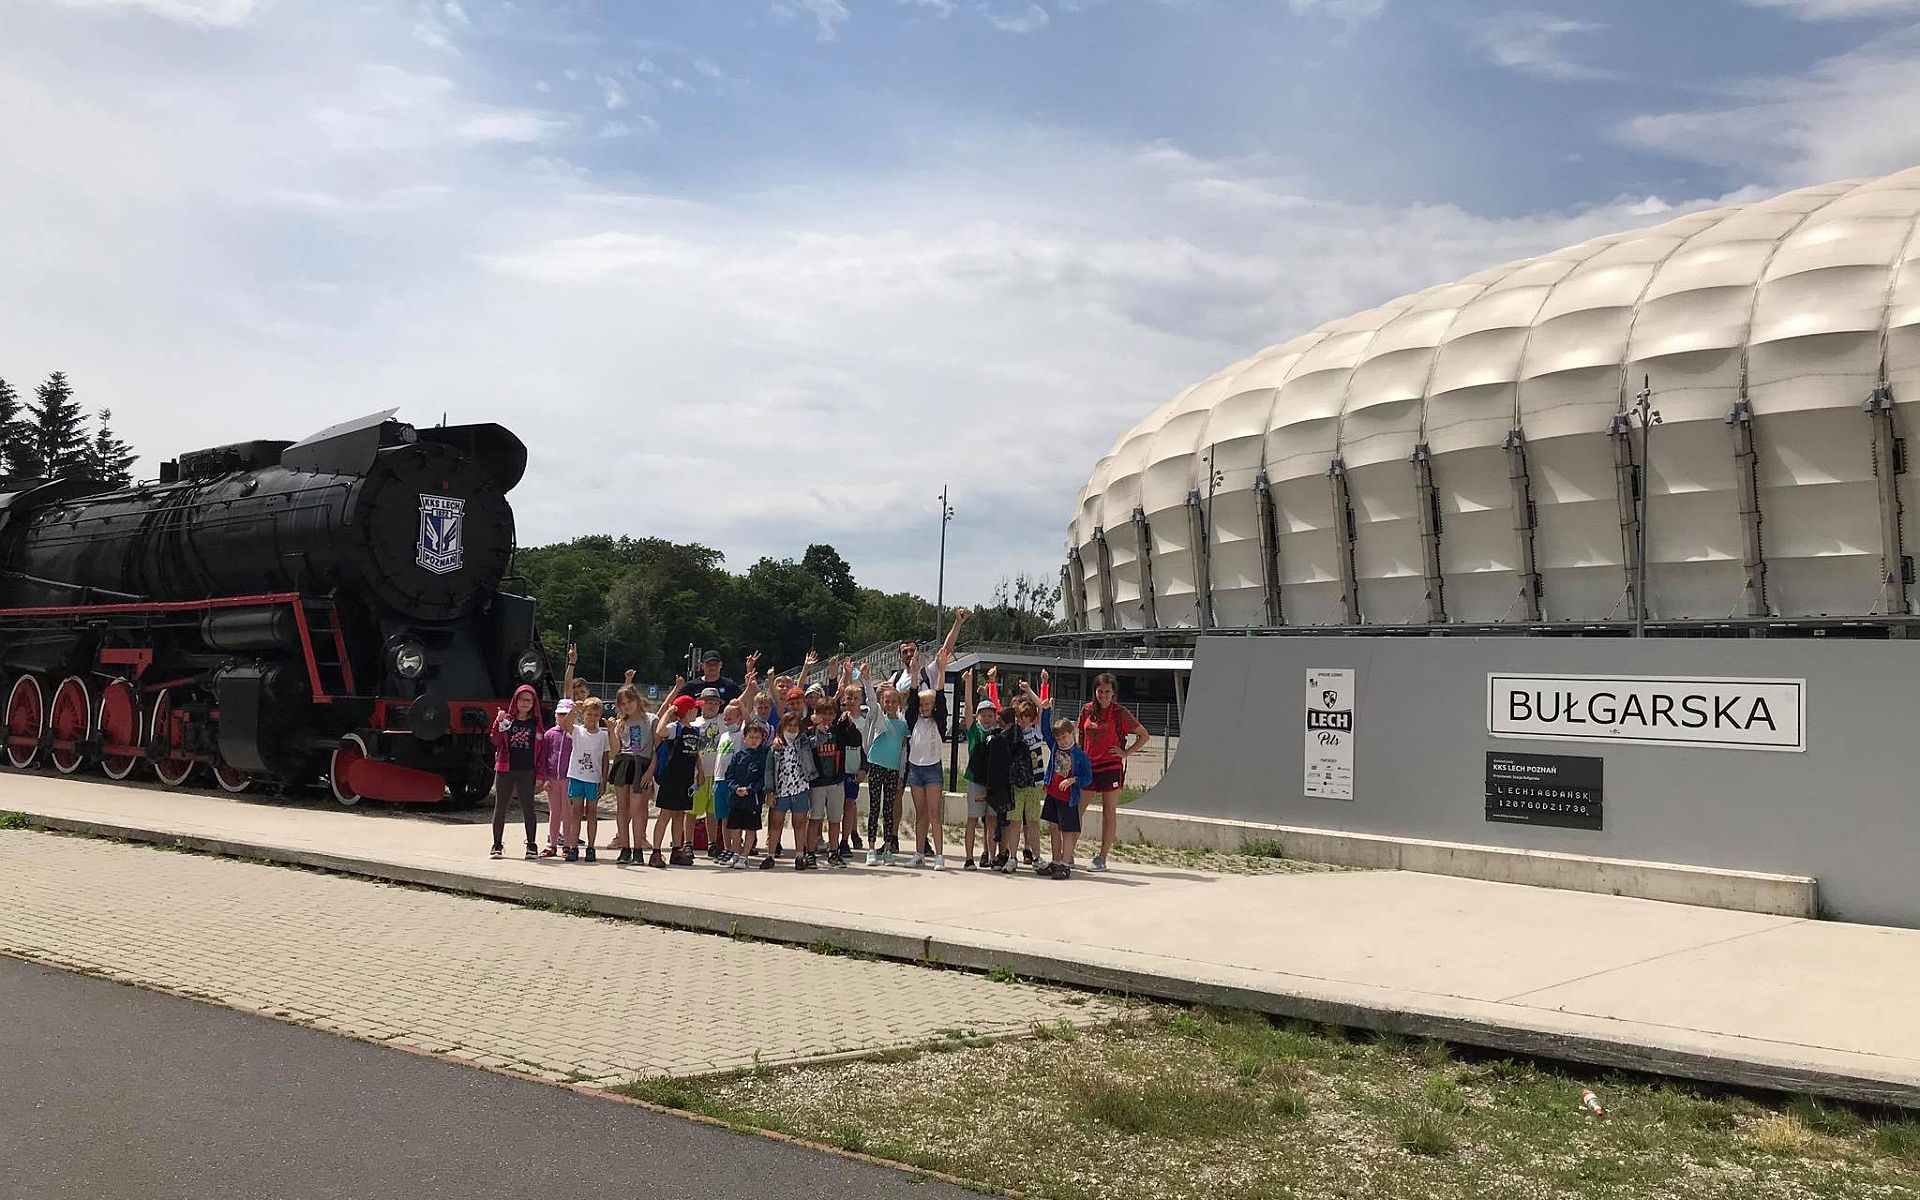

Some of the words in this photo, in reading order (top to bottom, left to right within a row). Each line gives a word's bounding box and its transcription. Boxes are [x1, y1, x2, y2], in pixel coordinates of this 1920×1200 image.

[424, 498, 440, 507] KKS
[441, 501, 461, 510] LECH
[1509, 689, 1777, 732] BUŁGARSKA
[1310, 712, 1348, 728] LECH
[1317, 731, 1340, 746] Pils
[1507, 765, 1526, 773] LECH
[1526, 765, 1557, 774] POZNAŃ
